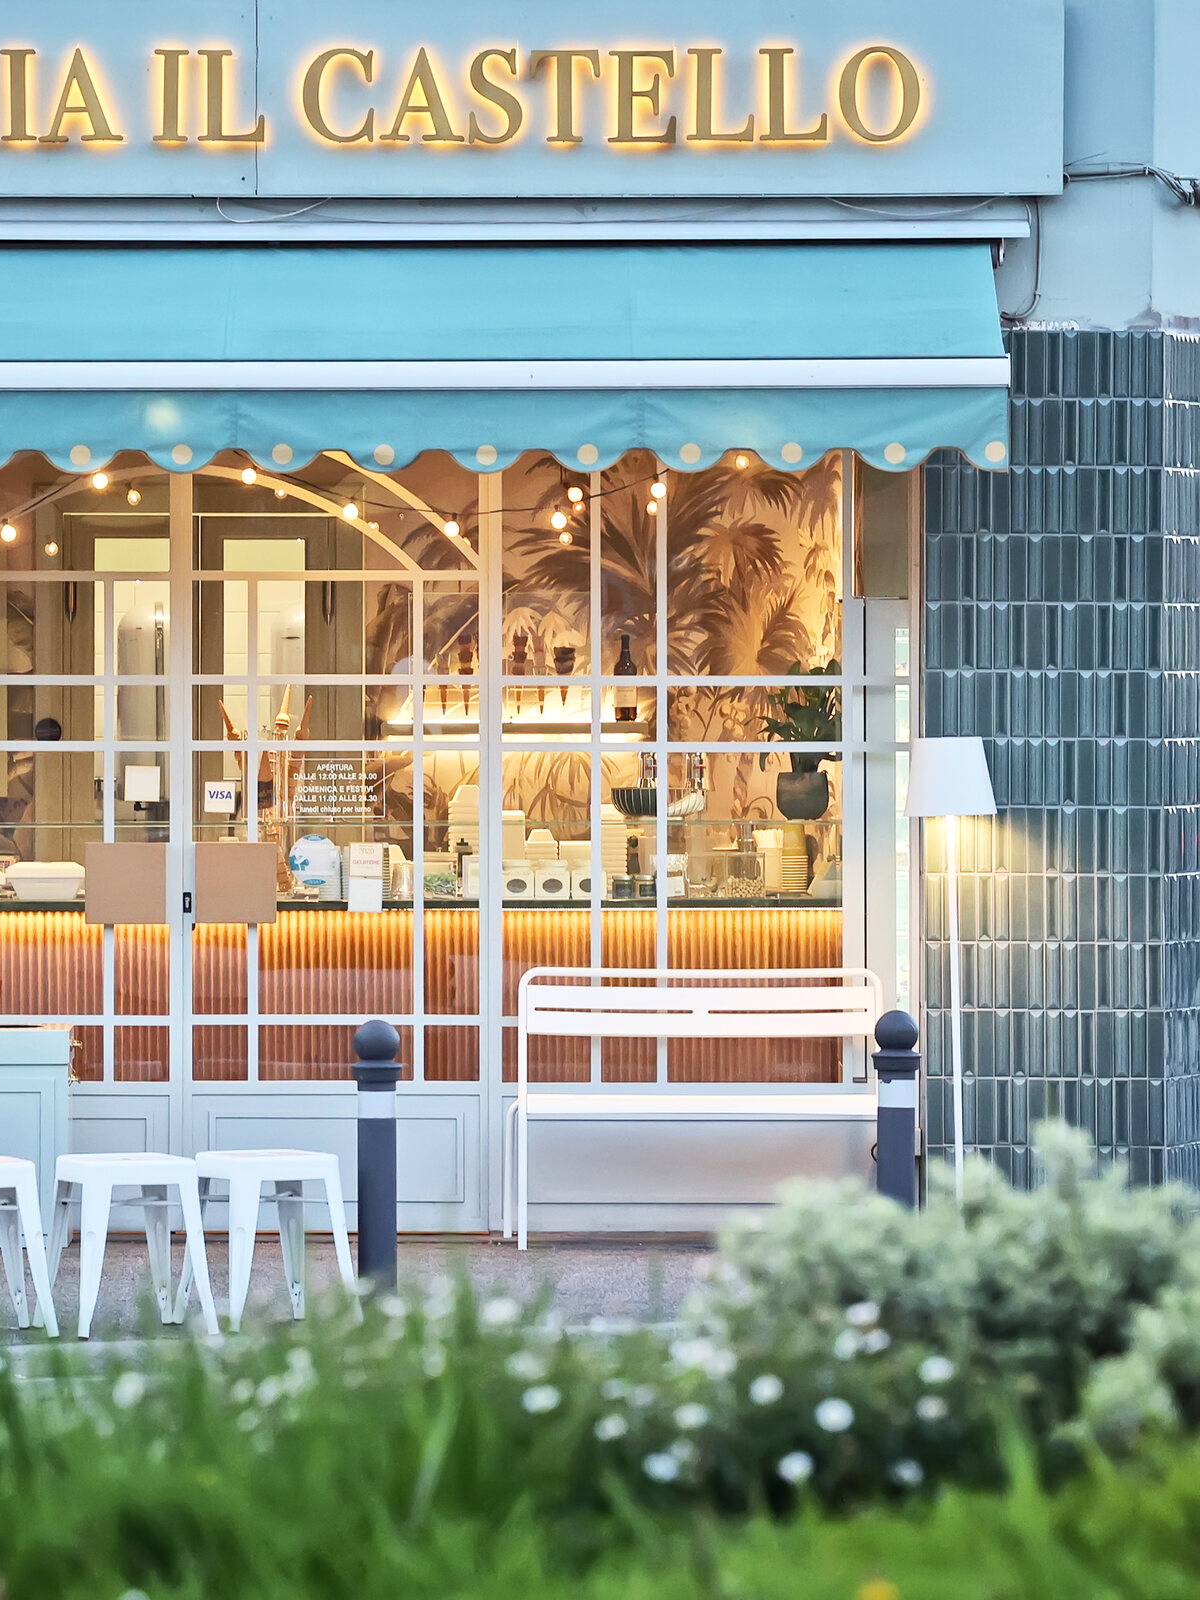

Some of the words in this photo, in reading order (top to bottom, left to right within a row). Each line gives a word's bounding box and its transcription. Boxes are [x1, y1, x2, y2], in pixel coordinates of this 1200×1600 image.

[153, 48, 266, 143] IL
[301, 46, 921, 144] CASTELLO
[316, 763, 354, 772] APERTURA
[293, 772, 317, 781] DALLE
[338, 772, 357, 781] ALLE
[297, 785, 338, 793] DOMENICA
[339, 785, 345, 793] E
[346, 785, 374, 793] FESTIVI
[208, 790, 232, 799] VISA
[293, 794, 317, 802] DALLE
[318, 794, 338, 802] 11.00
[338, 794, 357, 802] ALLE
[320, 805, 341, 813] chiuso
[342, 806, 354, 814] per
